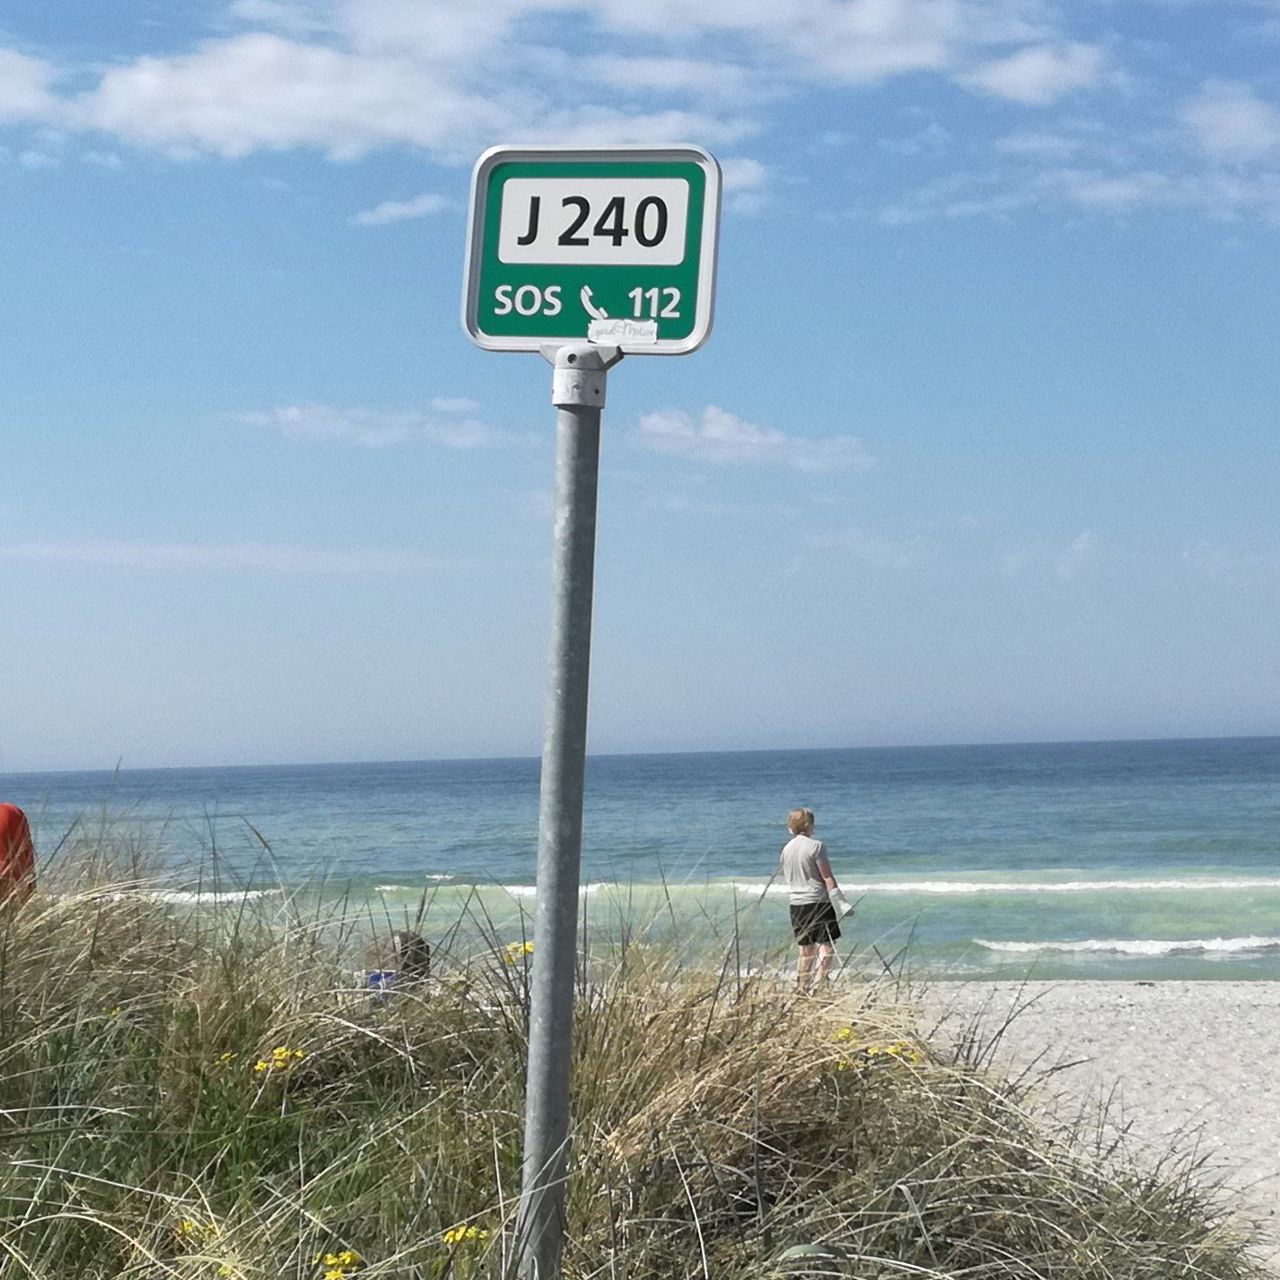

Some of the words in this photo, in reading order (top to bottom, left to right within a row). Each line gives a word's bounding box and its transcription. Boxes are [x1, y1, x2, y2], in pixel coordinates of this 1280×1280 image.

[517, 196, 540, 245] J
[557, 196, 668, 247] 240
[494, 285, 562, 315] SOS
[628, 287, 681, 318] 112
